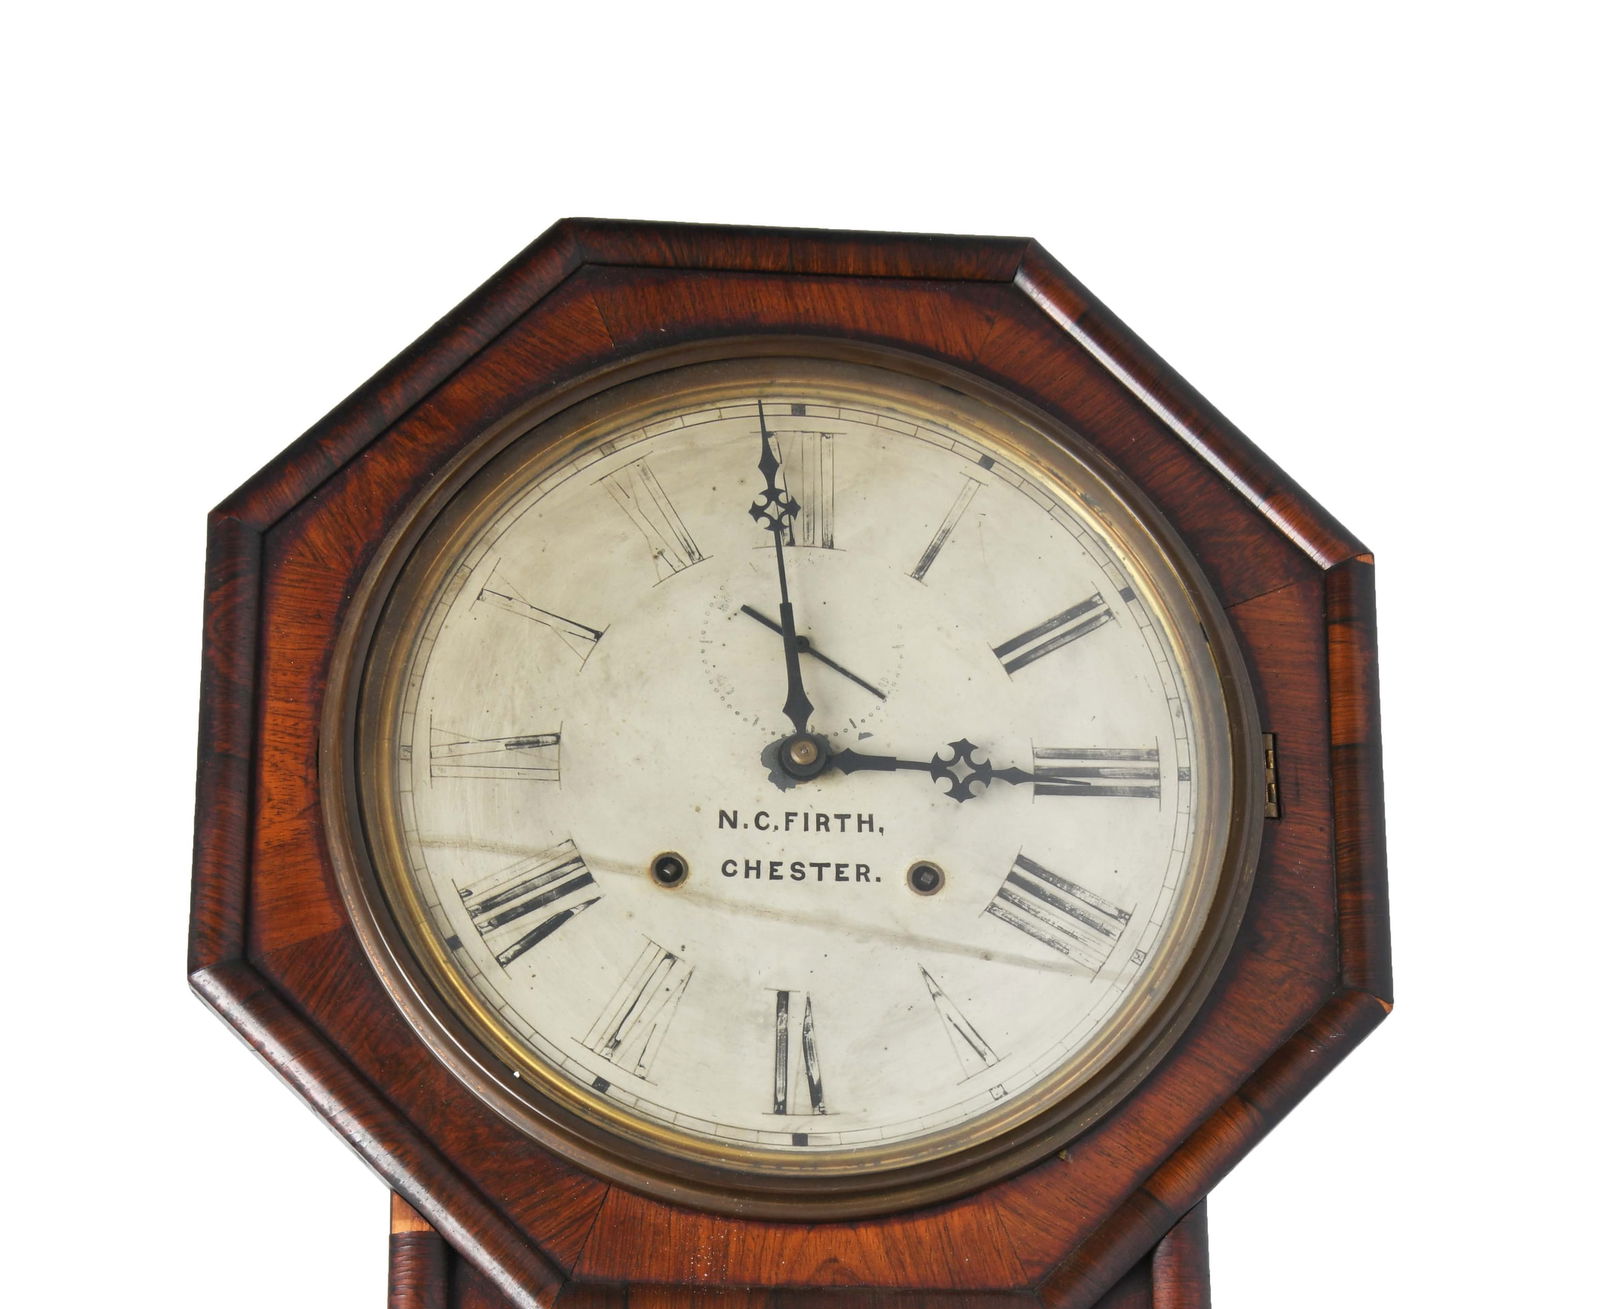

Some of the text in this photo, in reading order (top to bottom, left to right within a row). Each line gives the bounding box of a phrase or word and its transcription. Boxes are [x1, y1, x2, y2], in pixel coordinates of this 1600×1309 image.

[987, 580, 1122, 682] II
[1030, 736, 1162, 813] III
[452, 838, 606, 980] VIII
[721, 859, 882, 883] CHESTER.
[978, 845, 1138, 984] IIII
